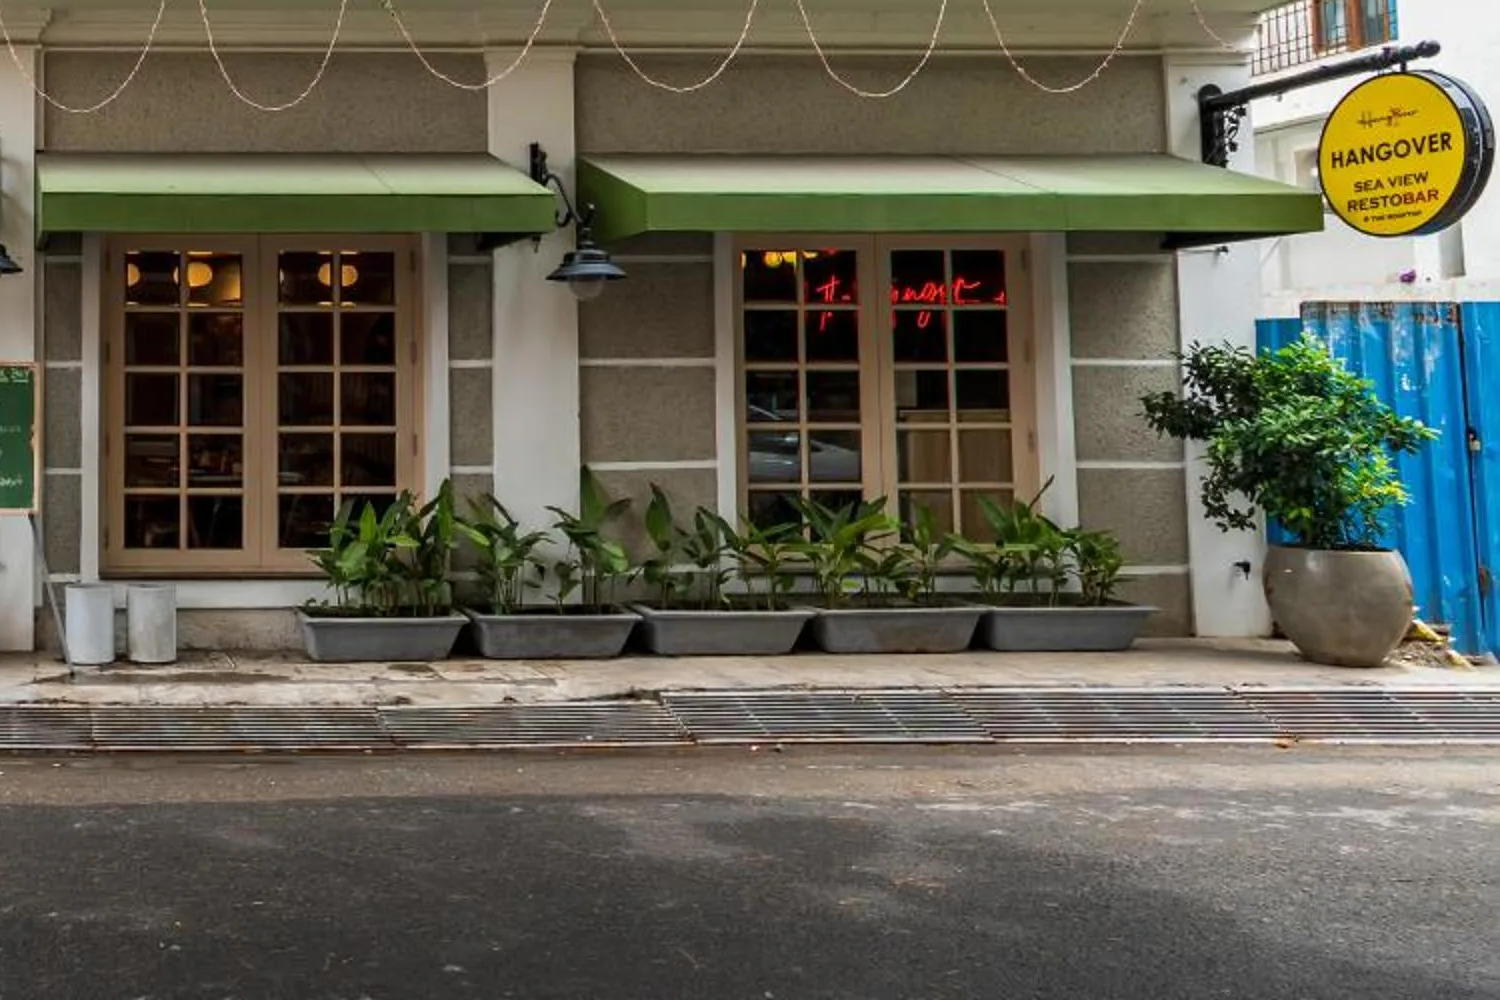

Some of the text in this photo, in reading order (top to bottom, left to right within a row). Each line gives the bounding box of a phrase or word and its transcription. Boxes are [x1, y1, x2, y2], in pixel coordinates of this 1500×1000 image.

[1331, 132, 1452, 169] HANGOVER
[1354, 171, 1429, 193] SEA VIEW
[1347, 189, 1439, 213] RESTOBAR
